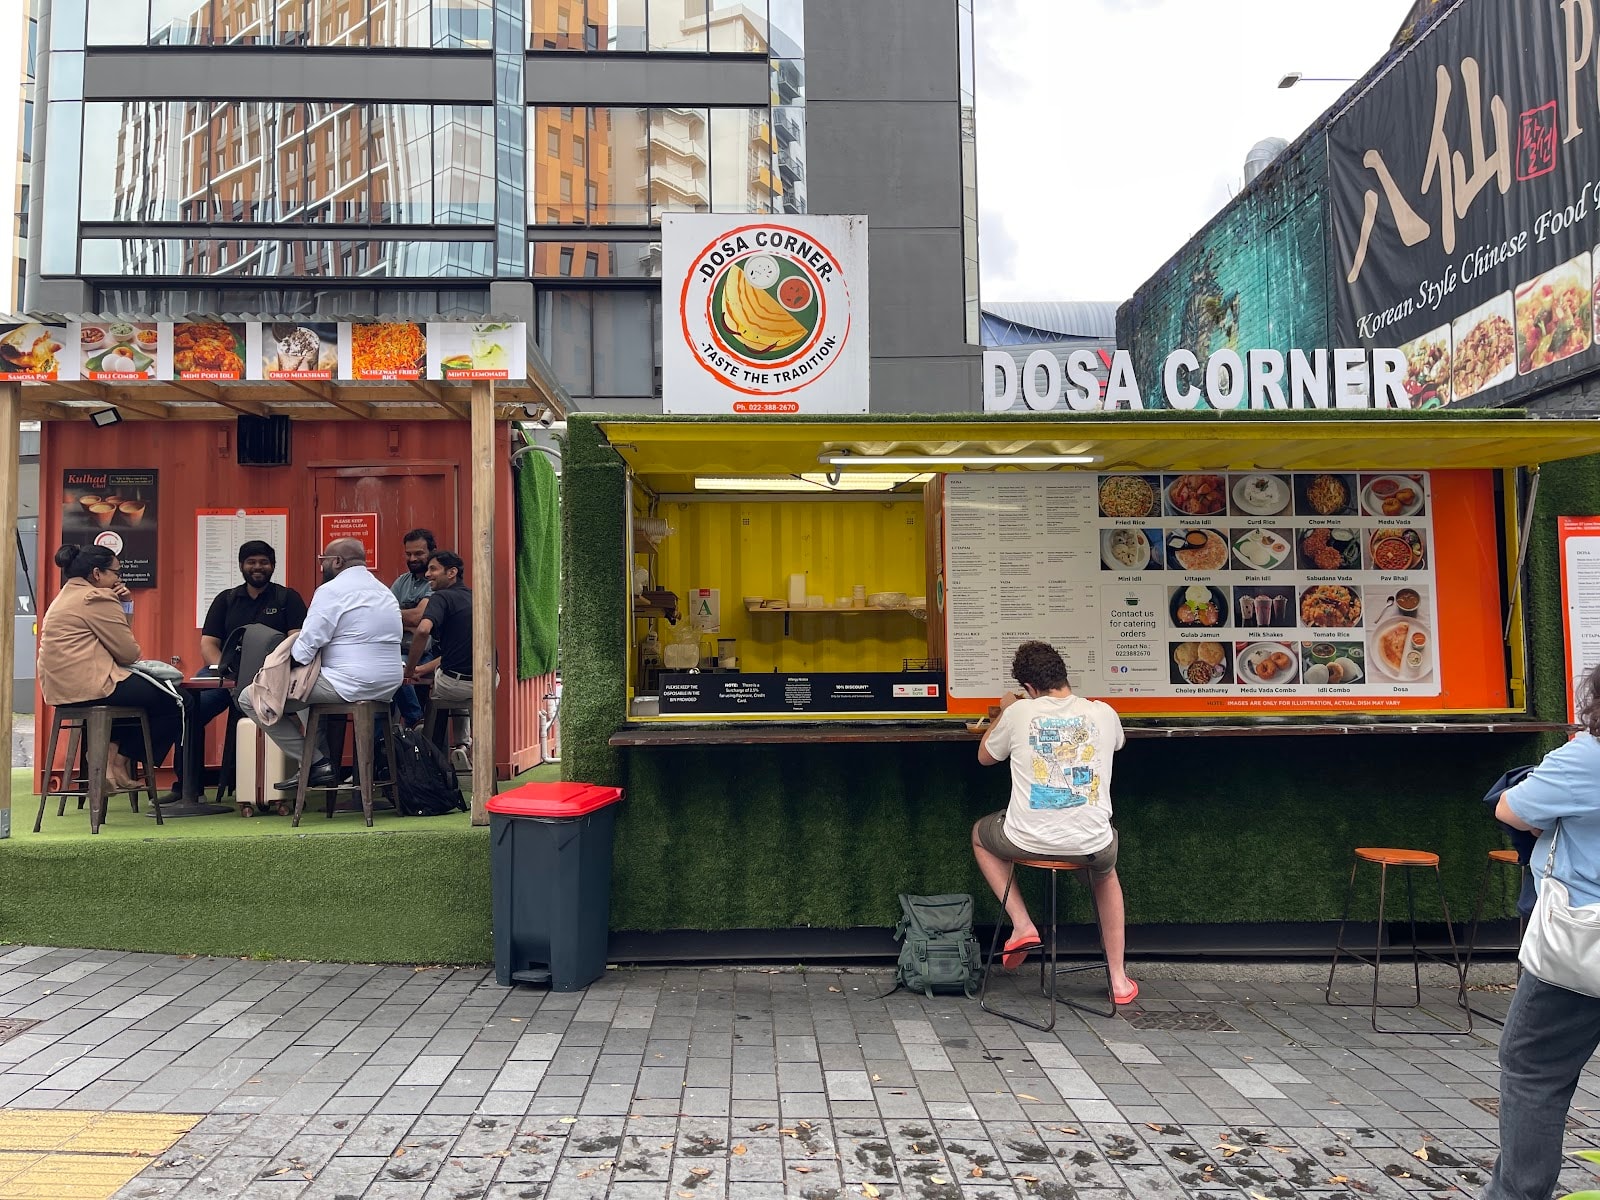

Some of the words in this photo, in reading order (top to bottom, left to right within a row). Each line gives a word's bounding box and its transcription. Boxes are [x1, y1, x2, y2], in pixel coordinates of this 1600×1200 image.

[1346, 57, 1511, 283] 八仙
[1356, 297, 1414, 340] Korean
[1417, 262, 1457, 312] Style
[1460, 229, 1528, 284] Chinese
[1533, 179, 1592, 245] Food
[743, 370, 769, 384] THE
[983, 348, 1146, 411] DOSA
[1163, 347, 1412, 411] CORNER
[68, 474, 106, 484] Kulhad
[697, 600, 712, 615] A
